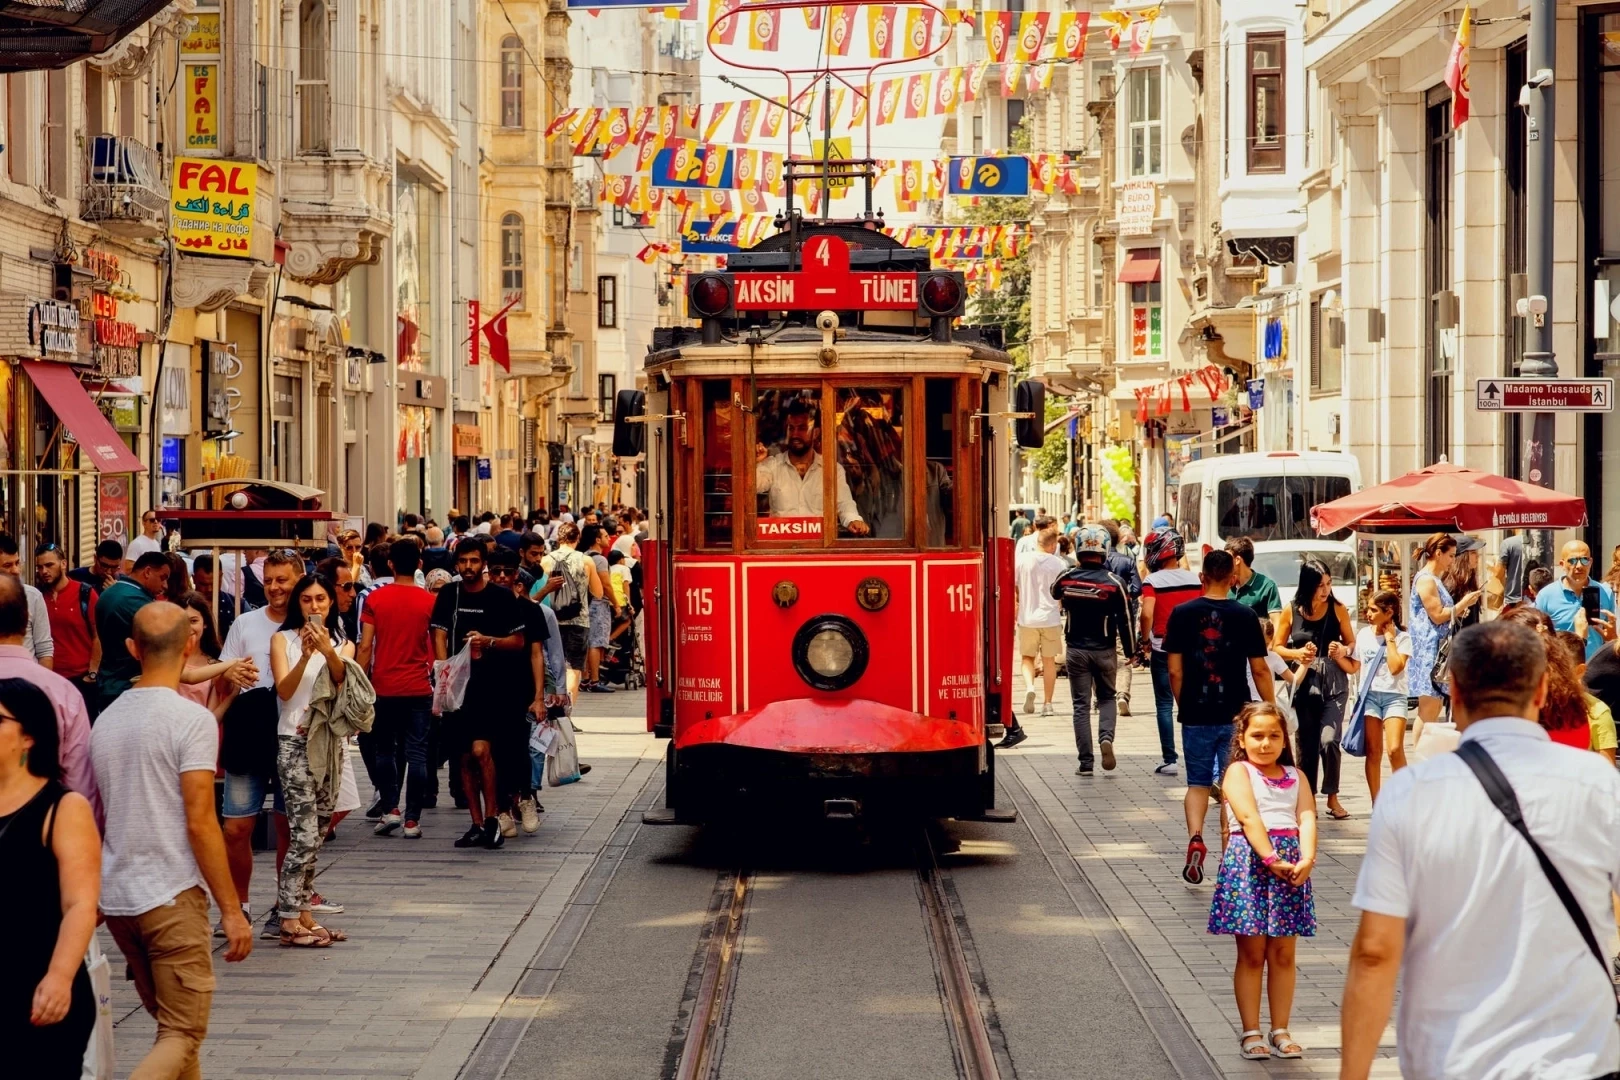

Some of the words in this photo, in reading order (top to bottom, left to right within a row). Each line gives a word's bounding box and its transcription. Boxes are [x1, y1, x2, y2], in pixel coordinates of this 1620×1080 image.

[193, 66, 209, 77] ES
[194, 77, 210, 134] FAL
[188, 135, 218, 145] CAFE
[178, 162, 249, 196] FAL
[175, 195, 209, 214] الكف
[213, 200, 250, 220] قراءة
[172, 215, 210, 231] Гадание
[212, 222, 223, 232] на
[225, 222, 249, 237] кофе
[815, 239, 830, 267] 4
[860, 275, 919, 304] TÜNEL
[1505, 384, 1543, 393] Madame
[1546, 384, 1591, 394] Tussauds
[1529, 395, 1567, 406] İstanbul
[1499, 511, 1520, 525] BEYOĞLU
[1520, 512, 1548, 524] BELEDİYESİ
[758, 520, 822, 535] TAKSİM
[686, 588, 713, 615] 115
[946, 584, 973, 612] 115
[700, 634, 713, 642] 153
[697, 678, 721, 689] YASAK
[938, 688, 949, 700] VE
